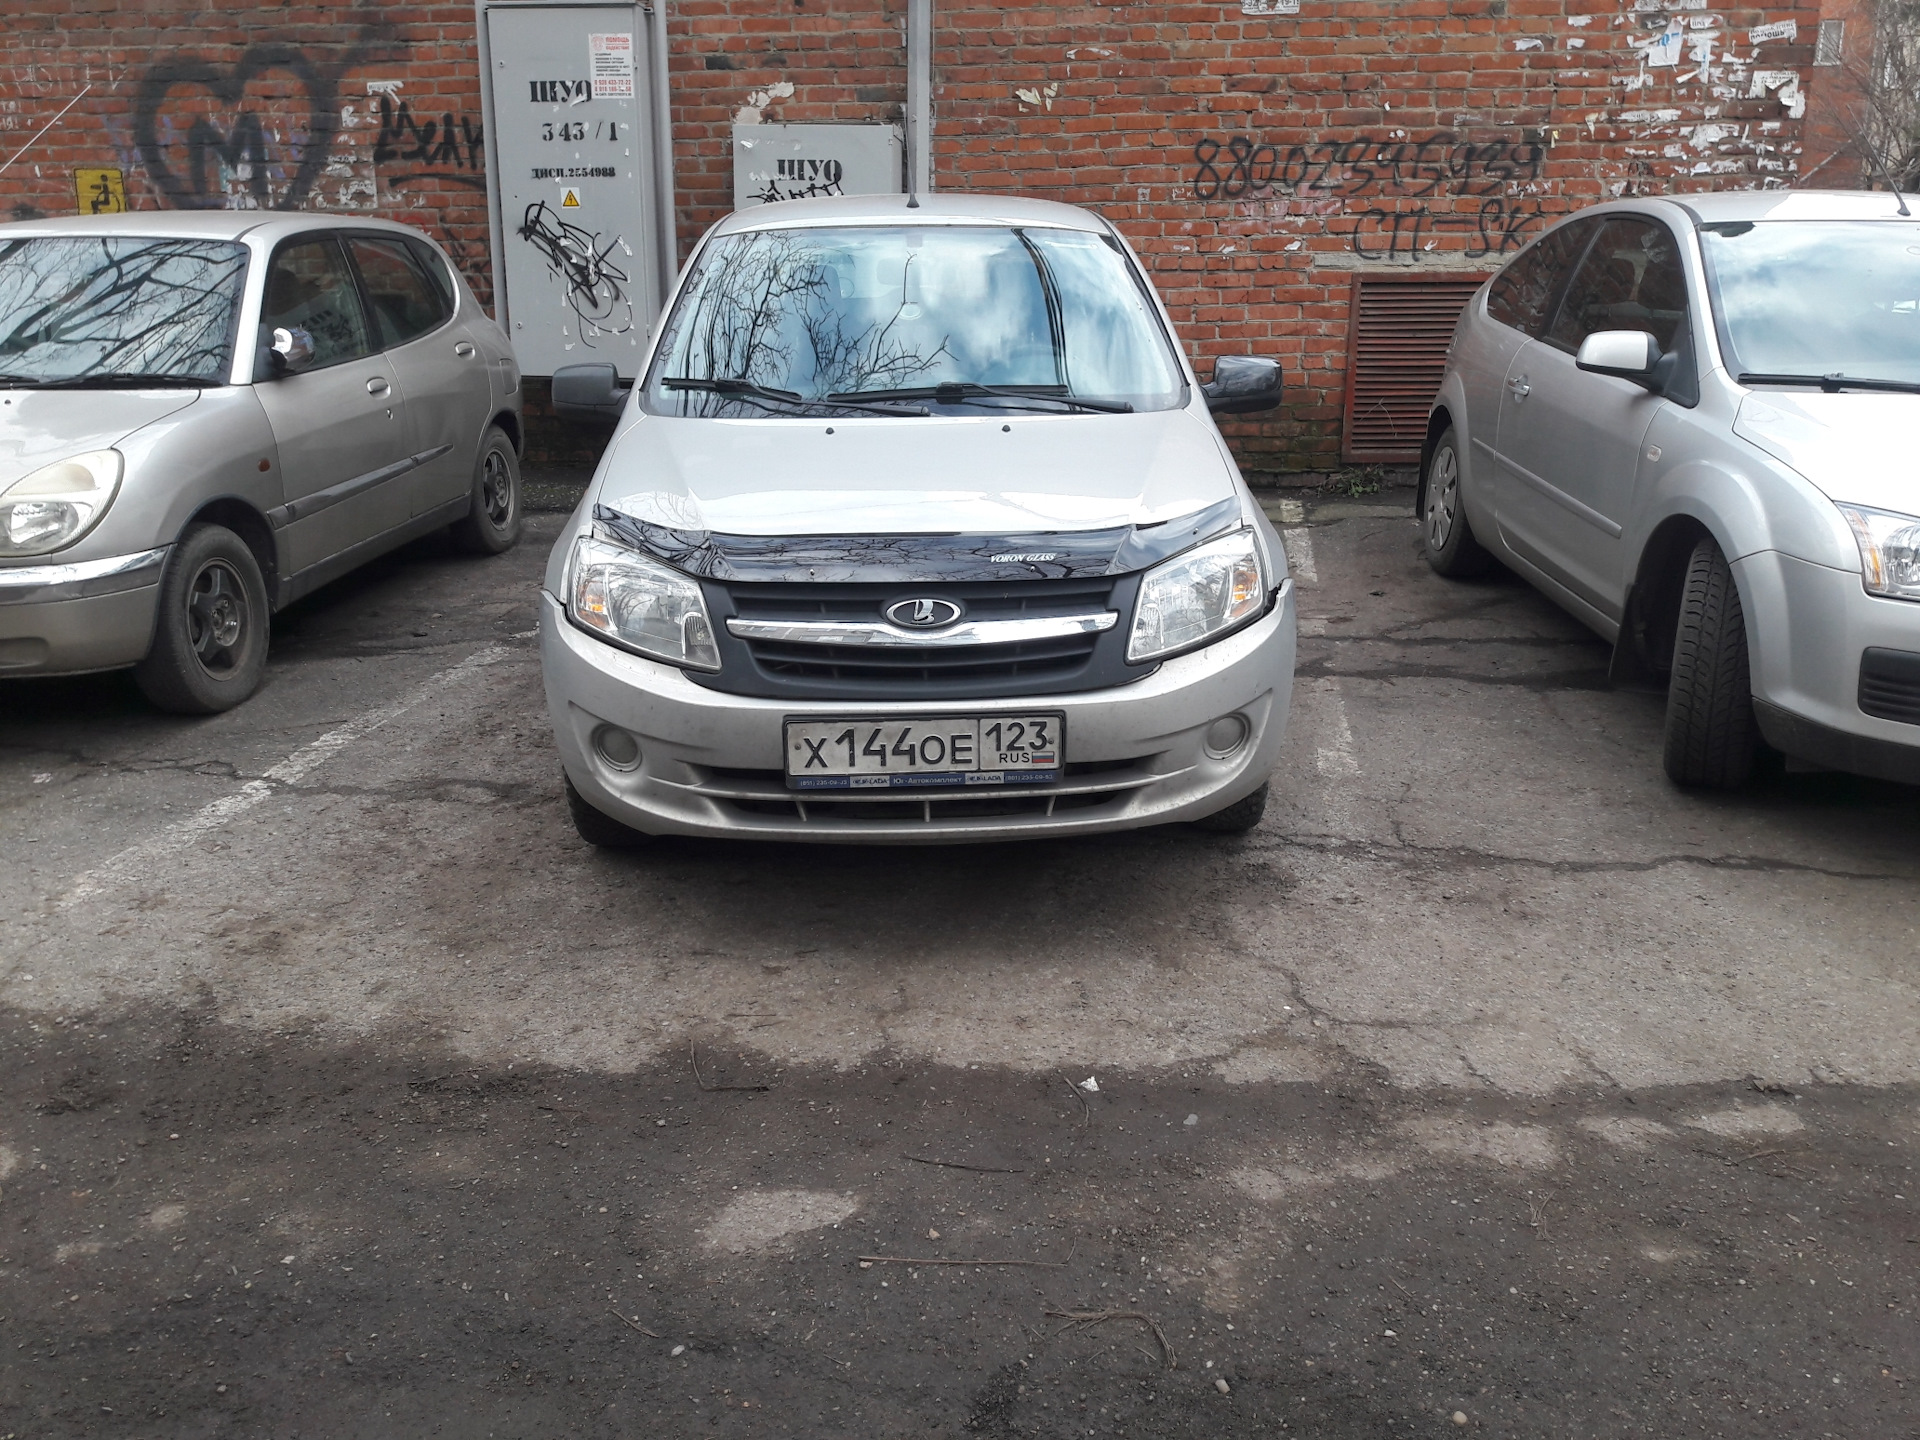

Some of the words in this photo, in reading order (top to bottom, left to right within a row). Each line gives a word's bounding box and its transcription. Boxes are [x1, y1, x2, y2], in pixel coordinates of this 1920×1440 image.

[777, 159, 843, 182] ШУО
[990, 554, 1025, 563] VORON
[1026, 553, 1056, 561] GLASS
[985, 721, 1048, 752] 123
[1000, 752, 1030, 764] RUS
